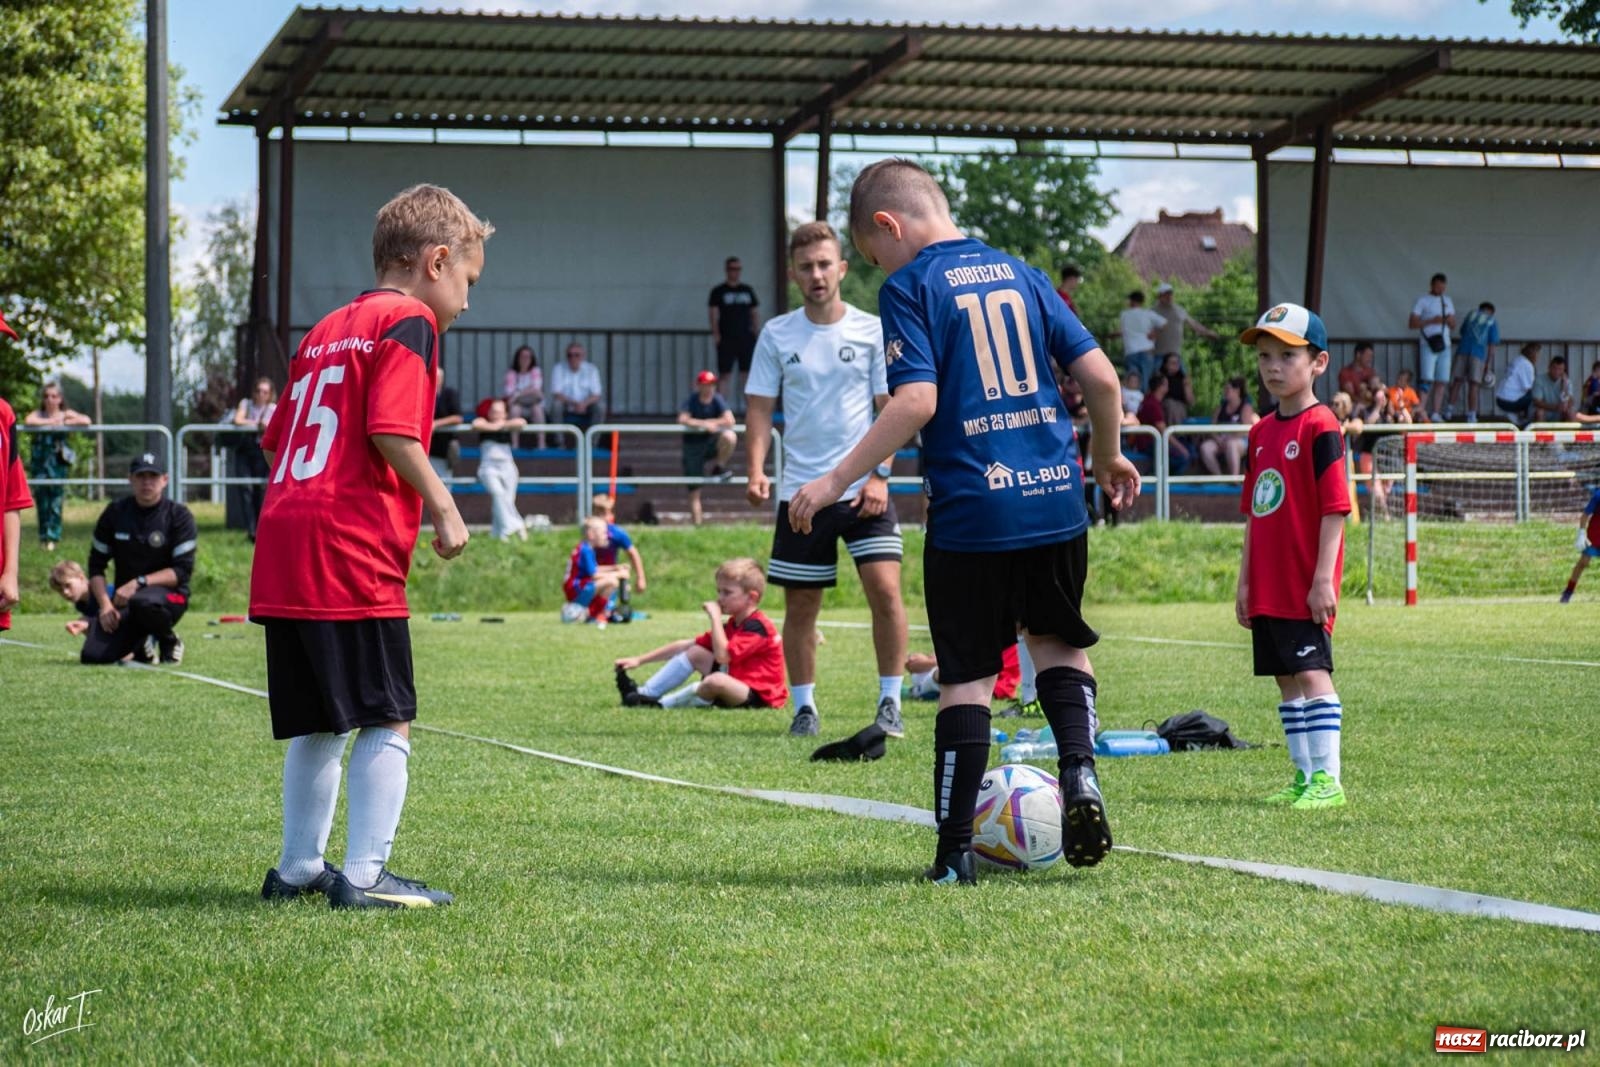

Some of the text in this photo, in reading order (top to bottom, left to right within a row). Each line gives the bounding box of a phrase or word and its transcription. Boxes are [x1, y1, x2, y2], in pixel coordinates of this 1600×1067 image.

[944, 262, 1016, 288] SOBECZKO
[955, 289, 1039, 400] 10
[963, 416, 989, 437] MKS
[1005, 408, 1040, 429] GMINA
[1017, 464, 1071, 487] EL-BUD
[1022, 486, 1045, 497] buduj
